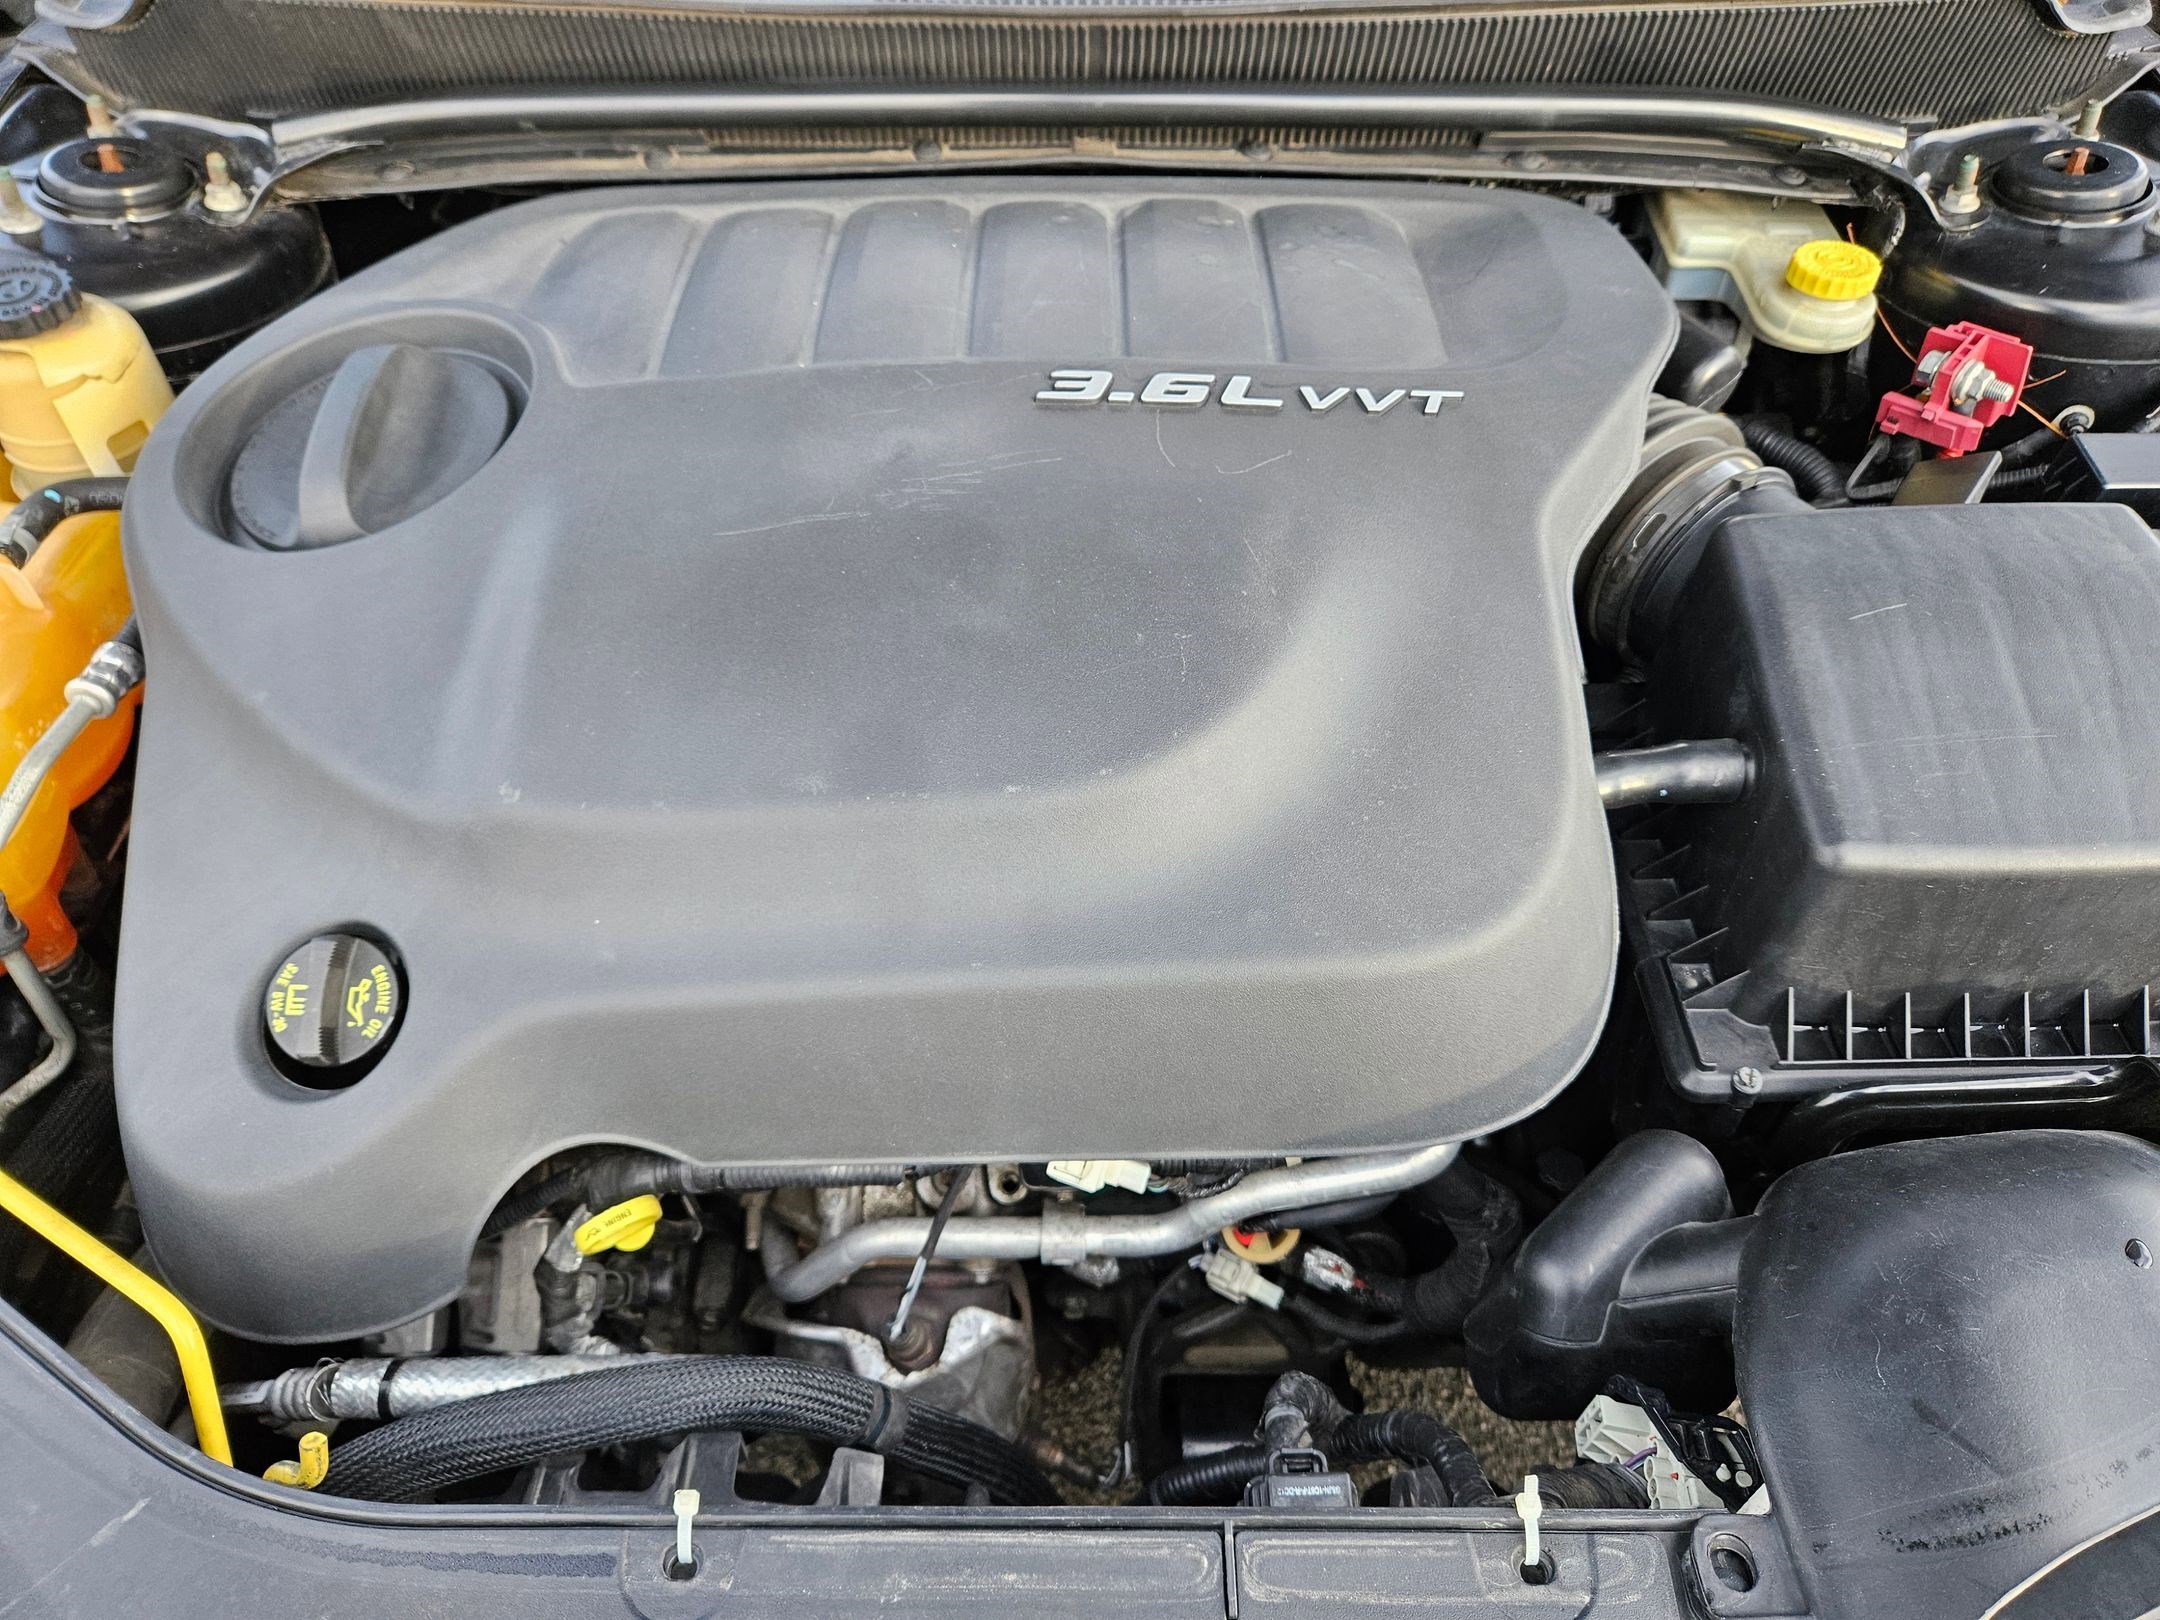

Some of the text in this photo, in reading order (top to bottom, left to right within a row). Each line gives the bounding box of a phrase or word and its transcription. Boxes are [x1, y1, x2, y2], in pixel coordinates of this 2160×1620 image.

[1034, 369, 1466, 415] 3.6L VVT
[276, 963, 299, 987] SAE
[361, 964, 391, 1038] ENGINE OIL
